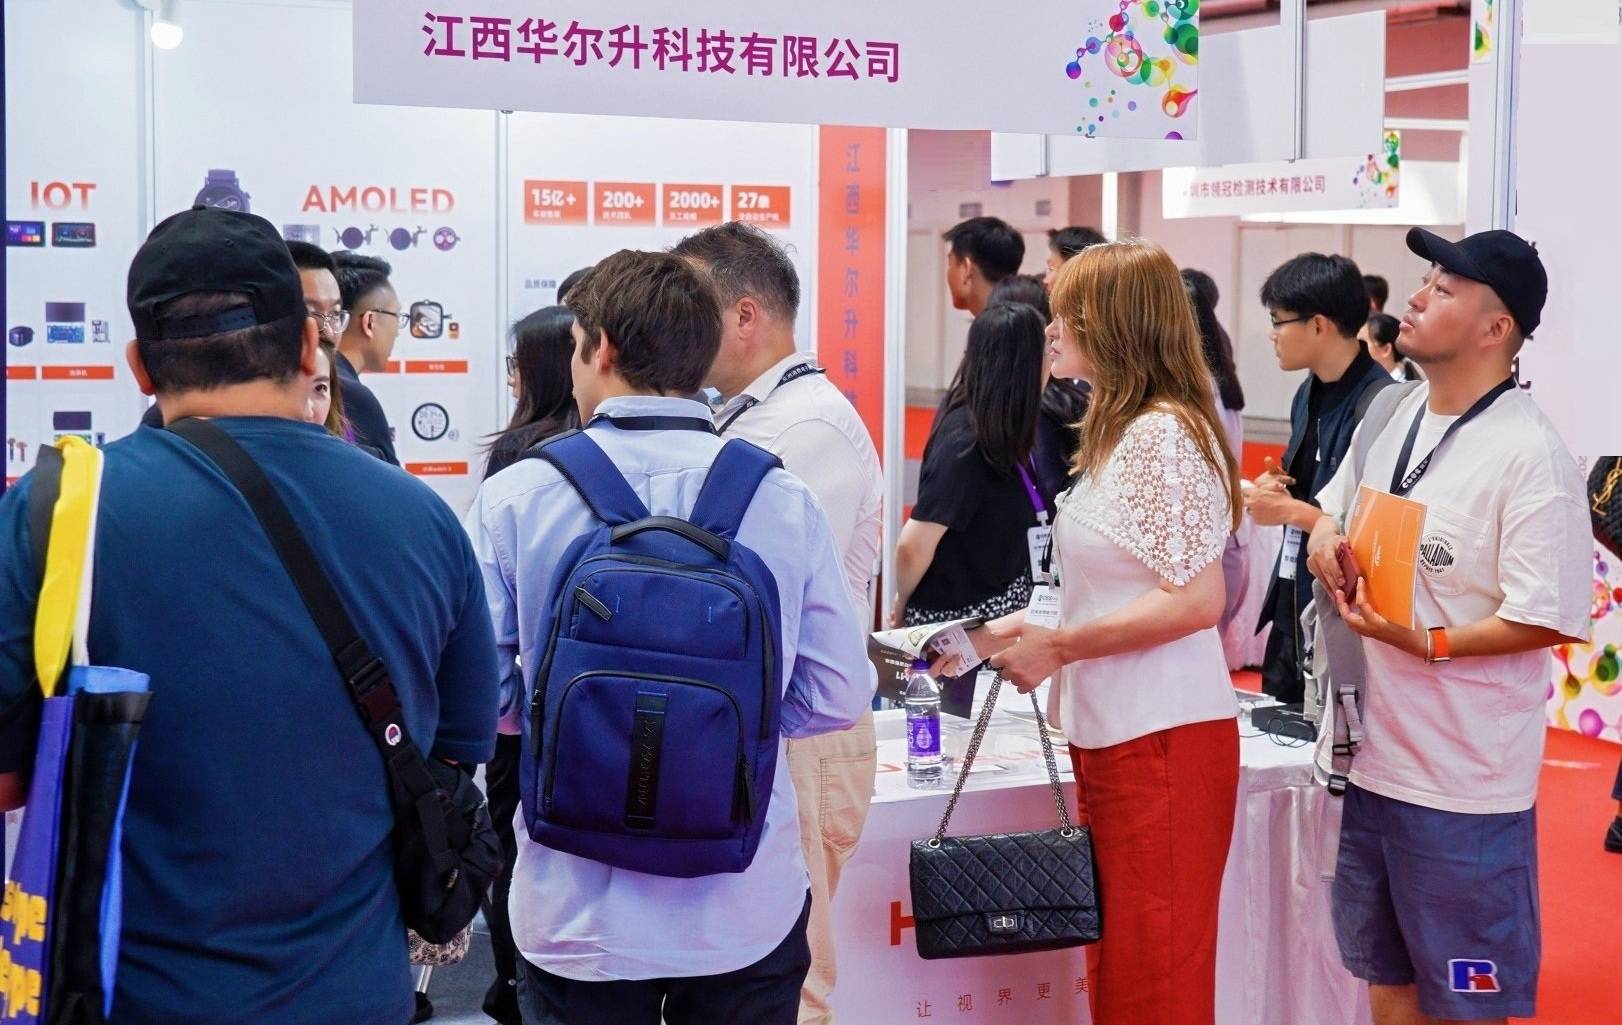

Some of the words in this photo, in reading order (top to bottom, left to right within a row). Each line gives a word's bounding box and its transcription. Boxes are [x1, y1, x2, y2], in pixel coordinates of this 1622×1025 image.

[421, 11, 900, 83] 江西华尔升科技有限公司
[30, 181, 97, 210] IOT
[302, 184, 455, 213] AMOLED
[1184, 175, 1326, 198] 圳市领冠检测技术有限公司
[603, 191, 645, 209] 200+
[670, 191, 721, 209] 2000+
